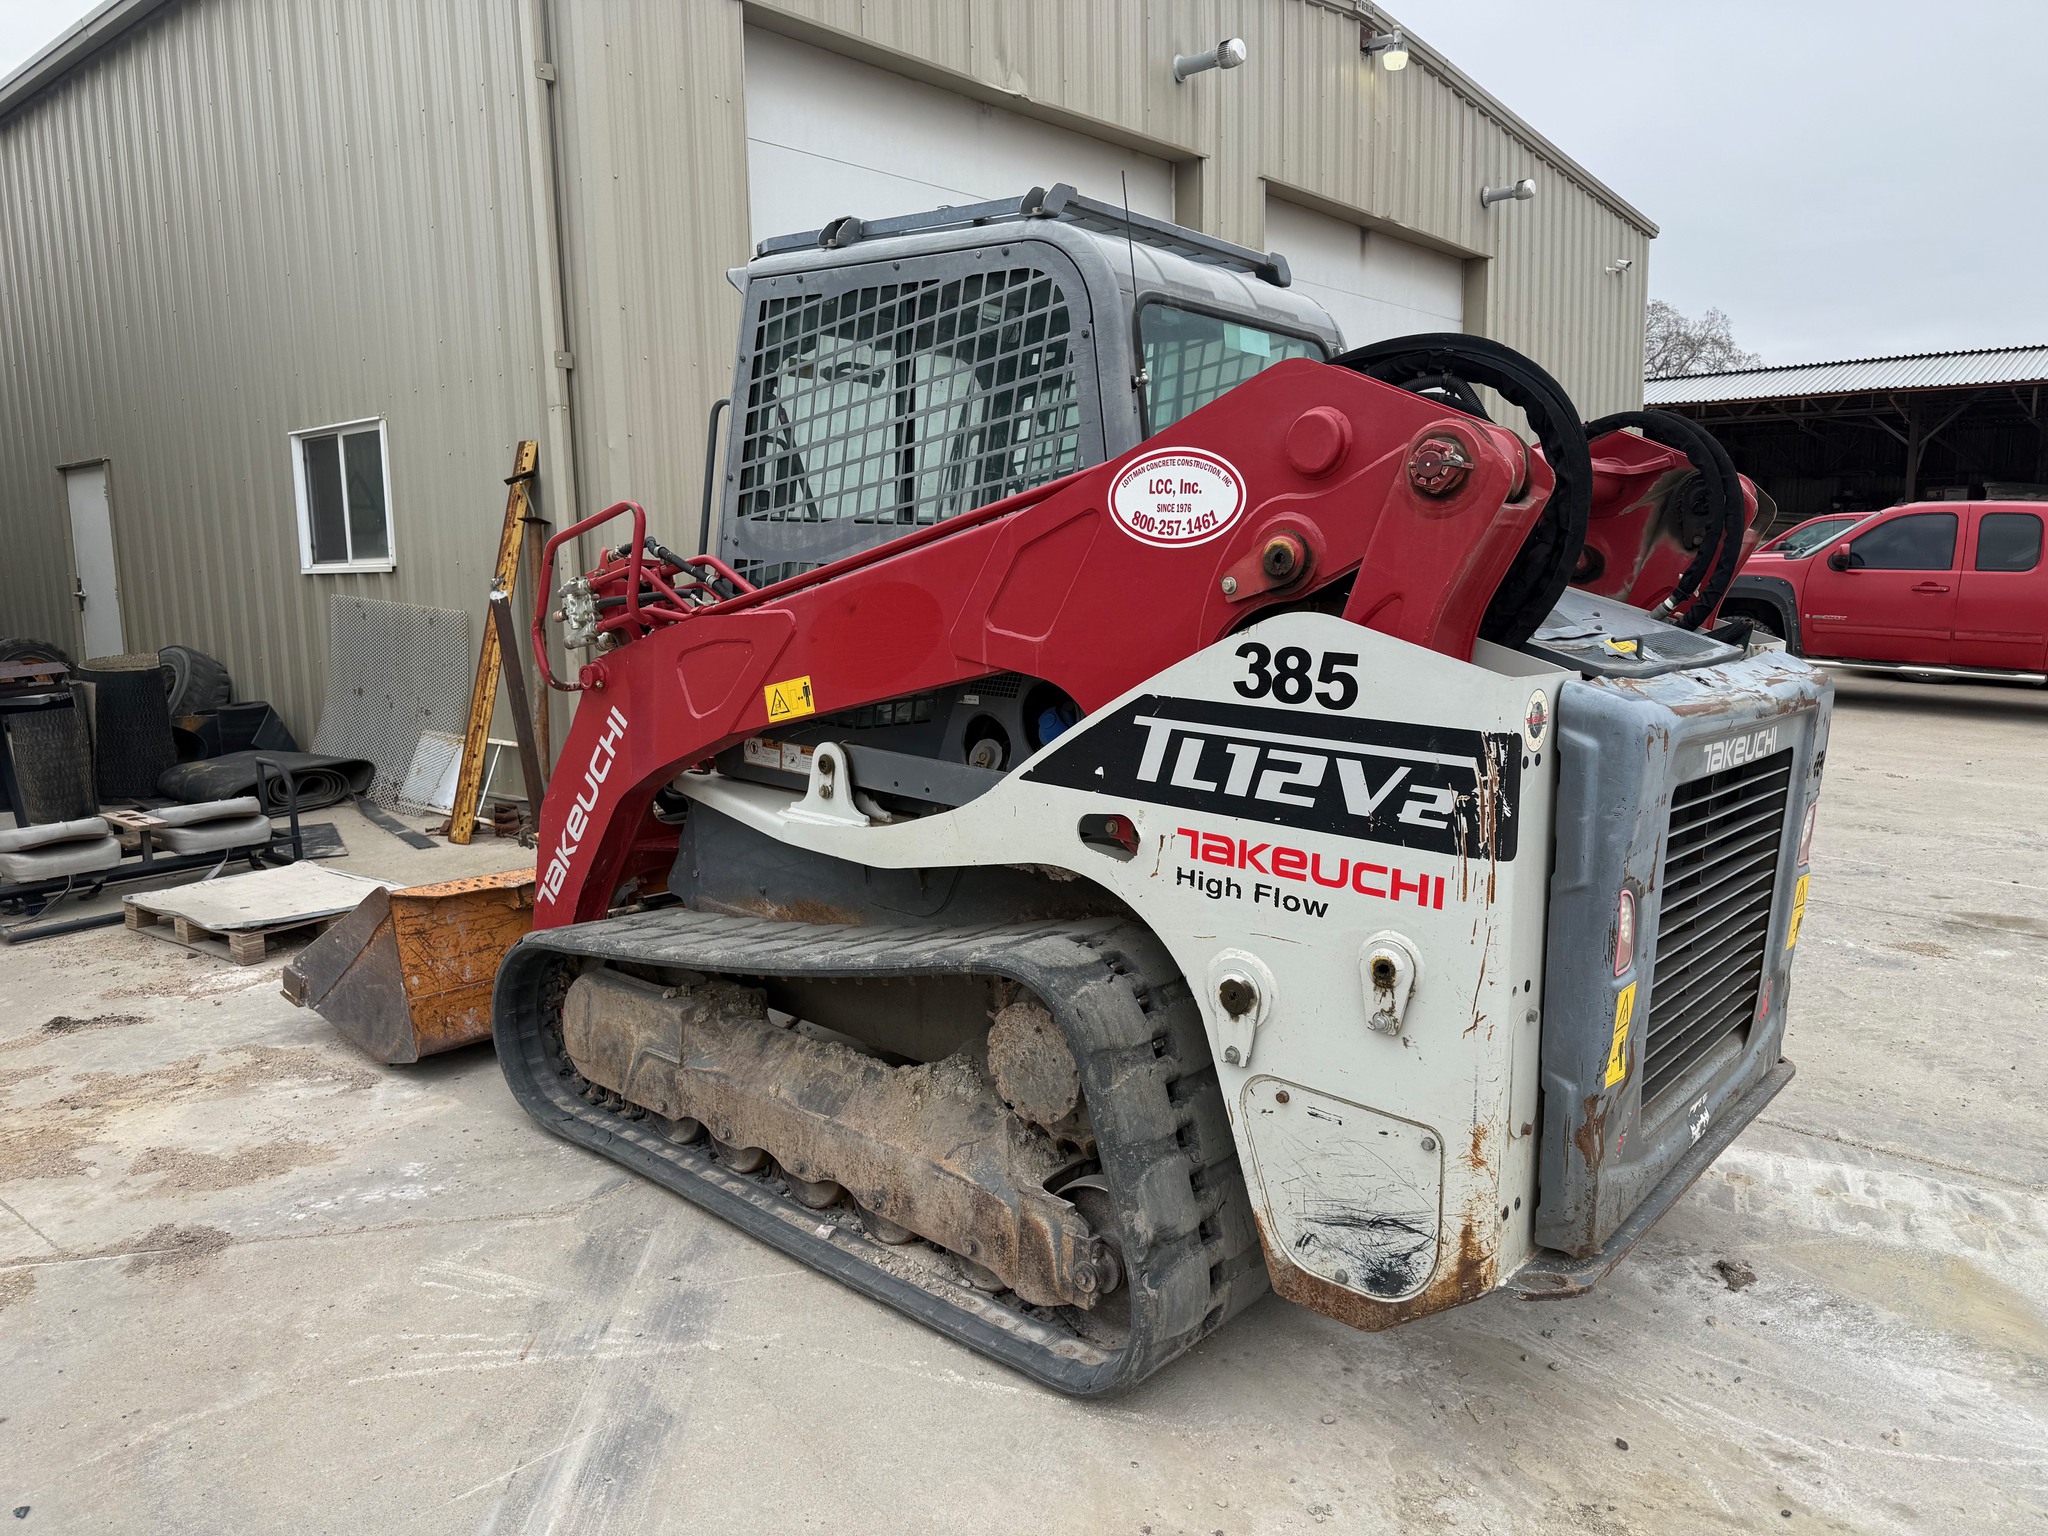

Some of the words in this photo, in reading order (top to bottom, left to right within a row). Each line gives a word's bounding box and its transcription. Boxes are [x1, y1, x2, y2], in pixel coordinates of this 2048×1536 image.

[1122, 466, 1146, 488] LOTTMAN
[1146, 458, 1176, 472] CONCRETE
[1177, 458, 1221, 479] CONSTRUCTION,
[1221, 474, 1232, 488] INC
[1149, 478, 1176, 497] LCC,
[1179, 478, 1202, 495] Inc.
[1156, 503, 1175, 513] SINCE
[1176, 503, 1192, 512] 1976
[1131, 509, 1219, 536] 800-257-1461
[1233, 641, 1359, 711] 385
[1176, 866, 1242, 900] High
[1254, 882, 1329, 919] Flow
